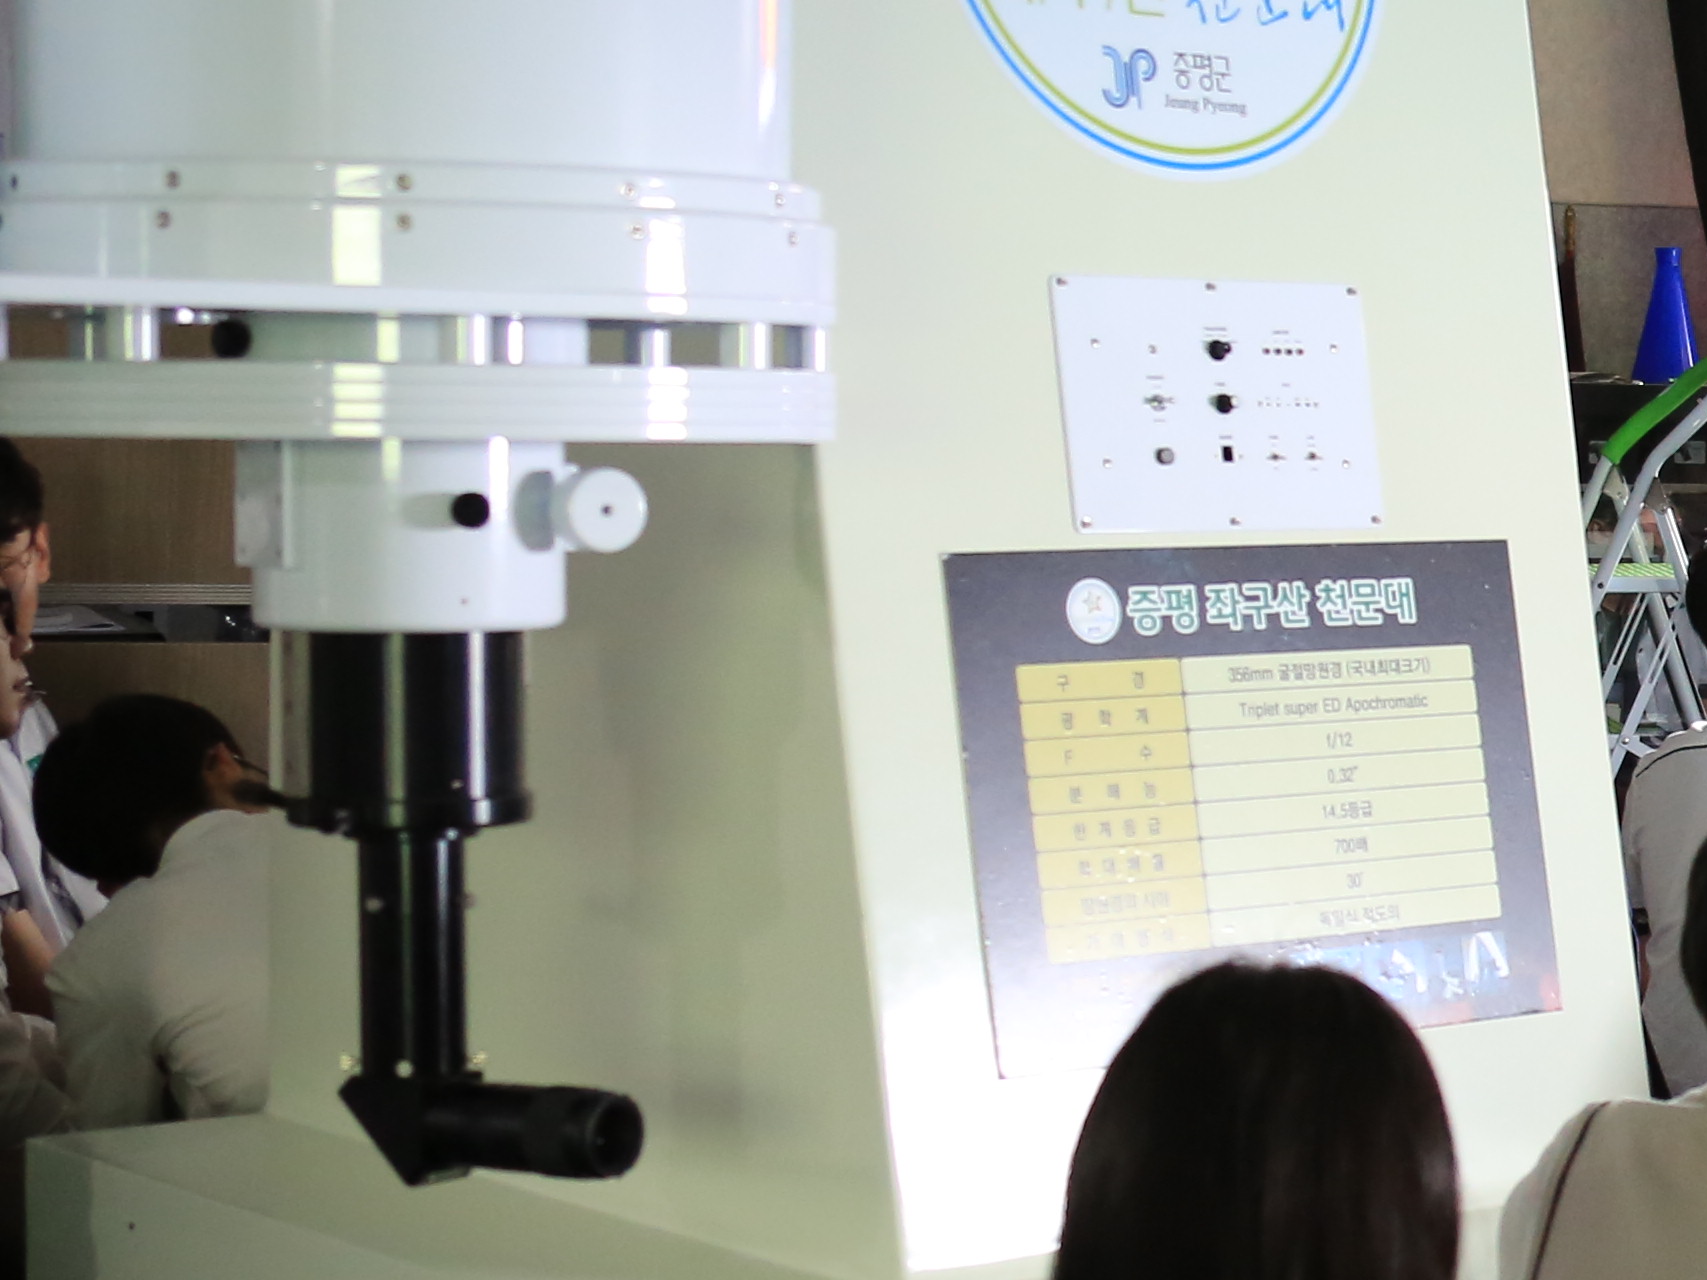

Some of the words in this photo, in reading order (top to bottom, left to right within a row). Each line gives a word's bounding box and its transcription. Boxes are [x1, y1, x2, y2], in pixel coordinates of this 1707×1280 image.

[1172, 51, 1233, 93] 증평군
[1126, 584, 1199, 637] 증평
[1204, 581, 1311, 632] 좌구산
[1315, 577, 1418, 627] 천문대
[1239, 700, 1280, 720] Triplet
[1283, 701, 1319, 719] super
[1322, 696, 1342, 714] ED
[1344, 693, 1430, 714] Apochromatic
